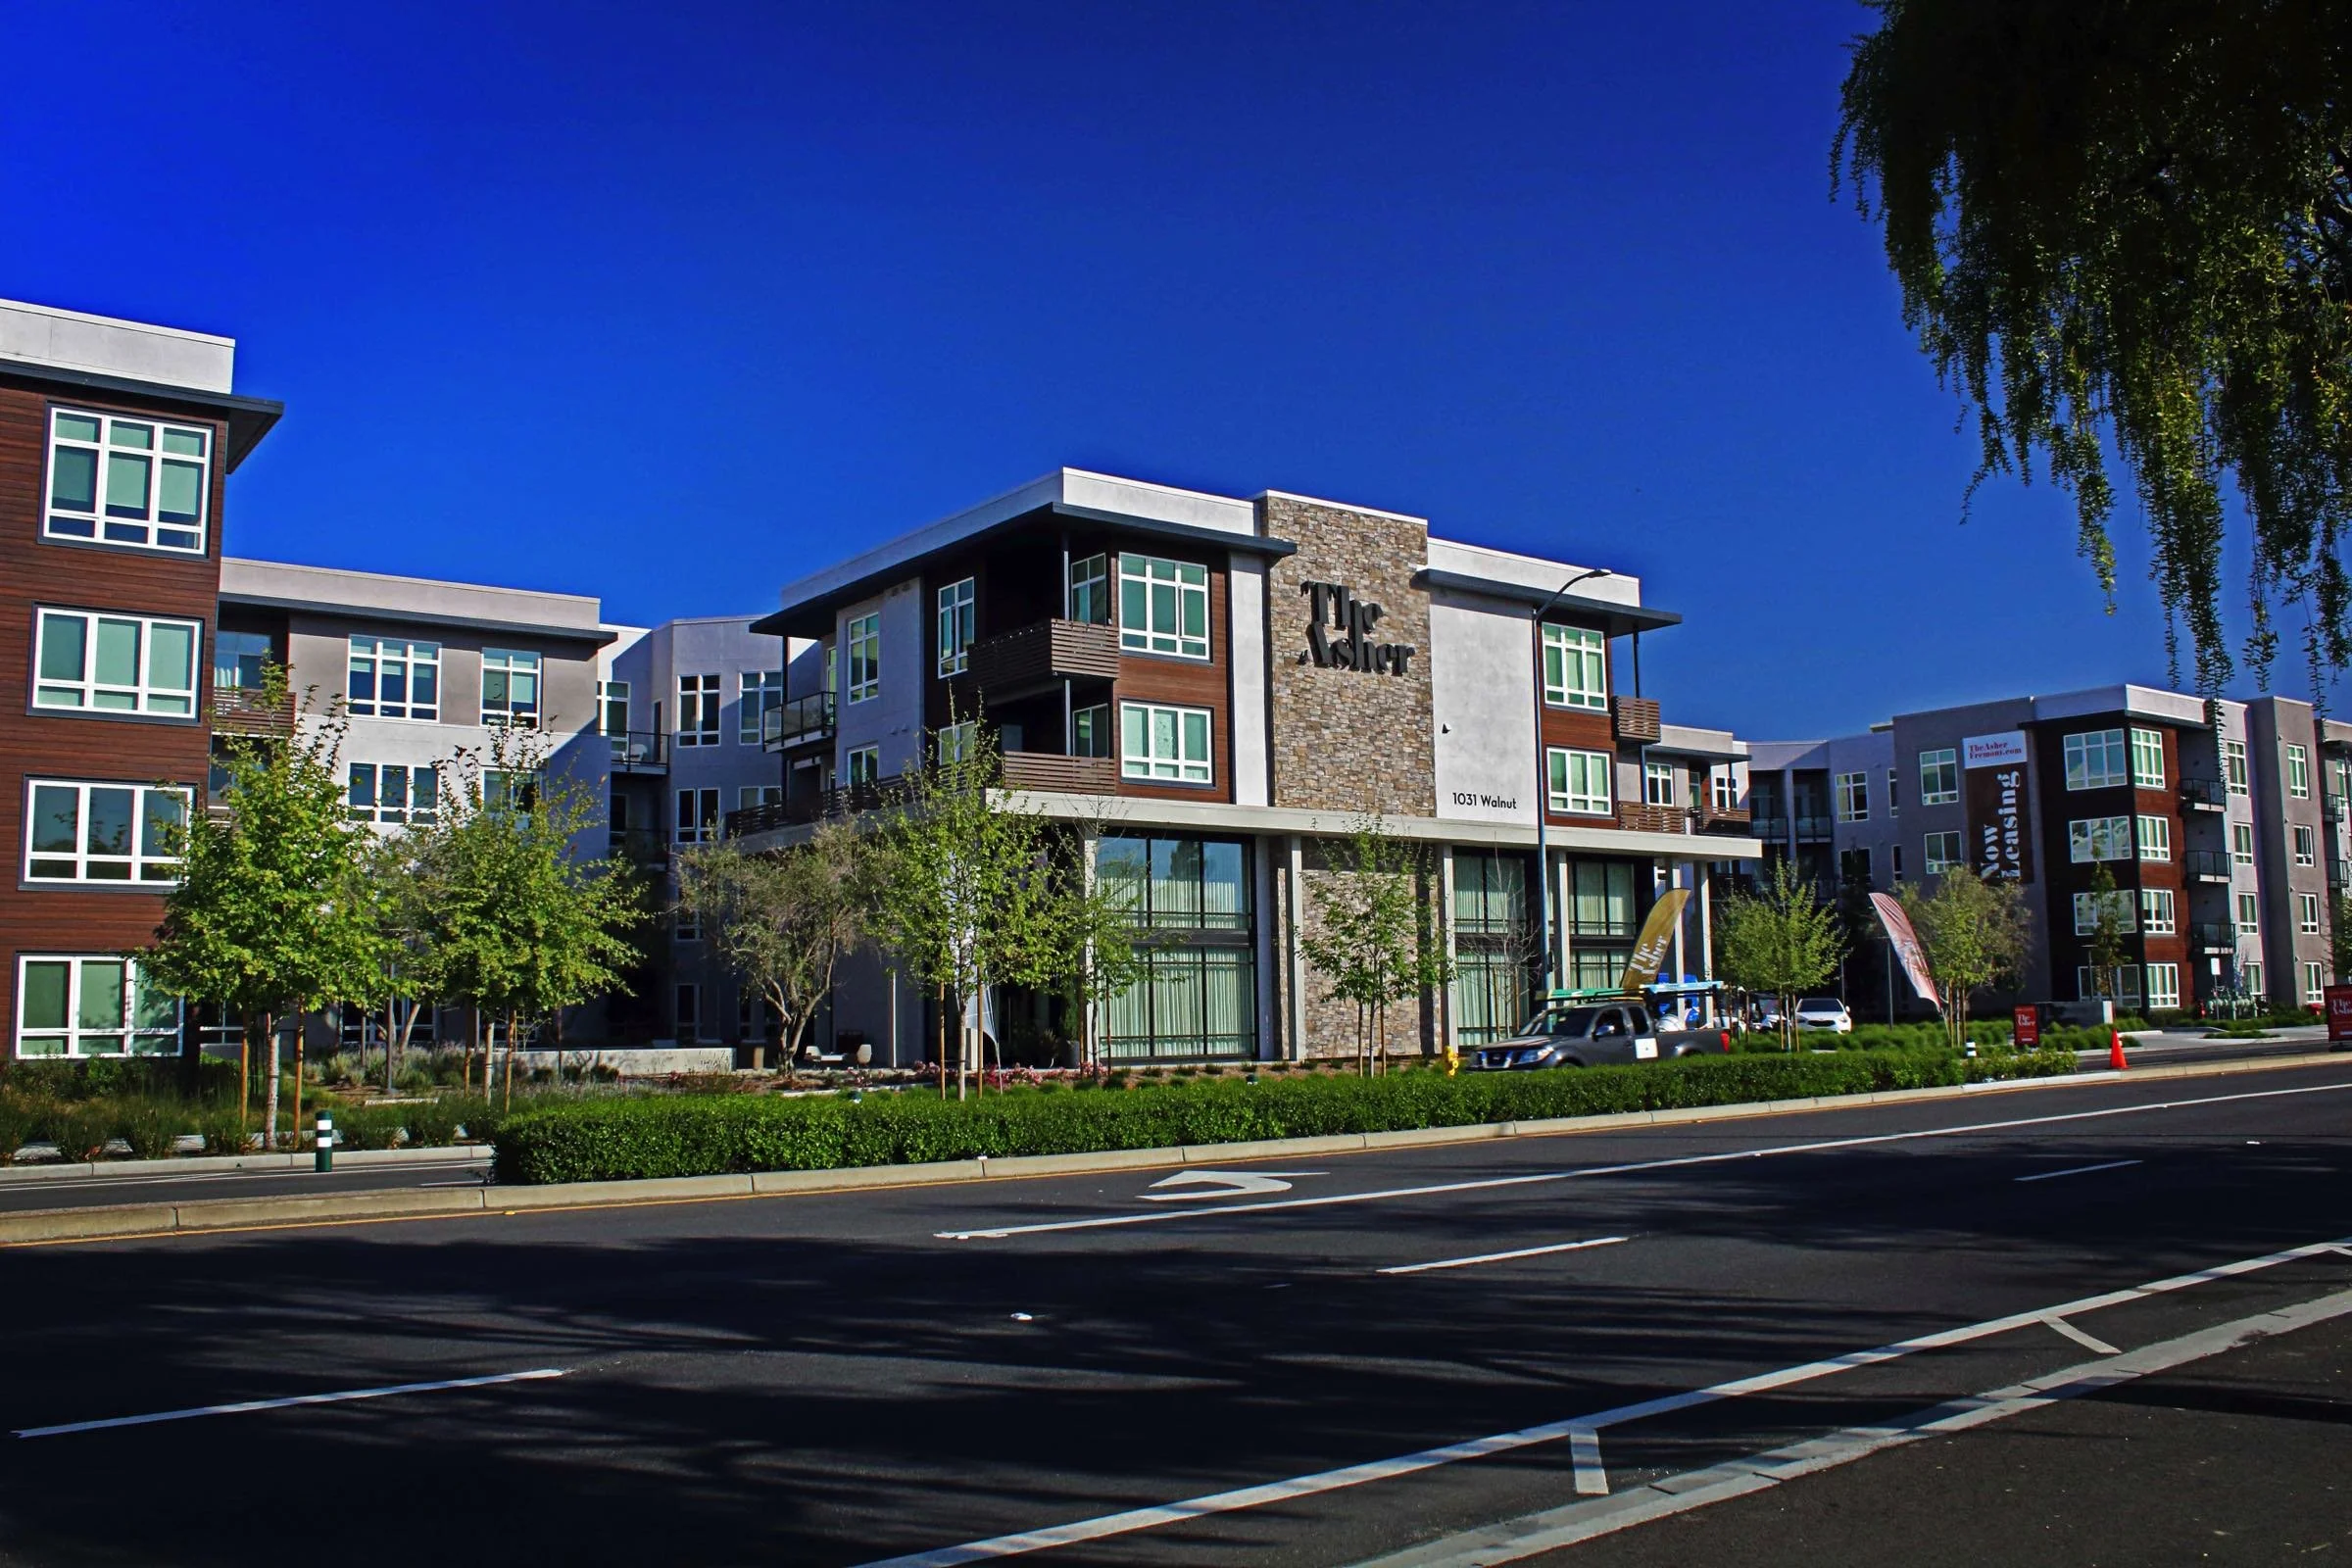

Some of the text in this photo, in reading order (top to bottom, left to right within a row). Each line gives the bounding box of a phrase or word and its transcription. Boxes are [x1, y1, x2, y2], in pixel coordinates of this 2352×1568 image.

[1299, 580, 1384, 634] The
[1296, 622, 1416, 676] Asher
[1452, 792, 1517, 809] 1031 Walnut
[1997, 771, 2021, 878] Leasing
[1981, 824, 1999, 878] Now
